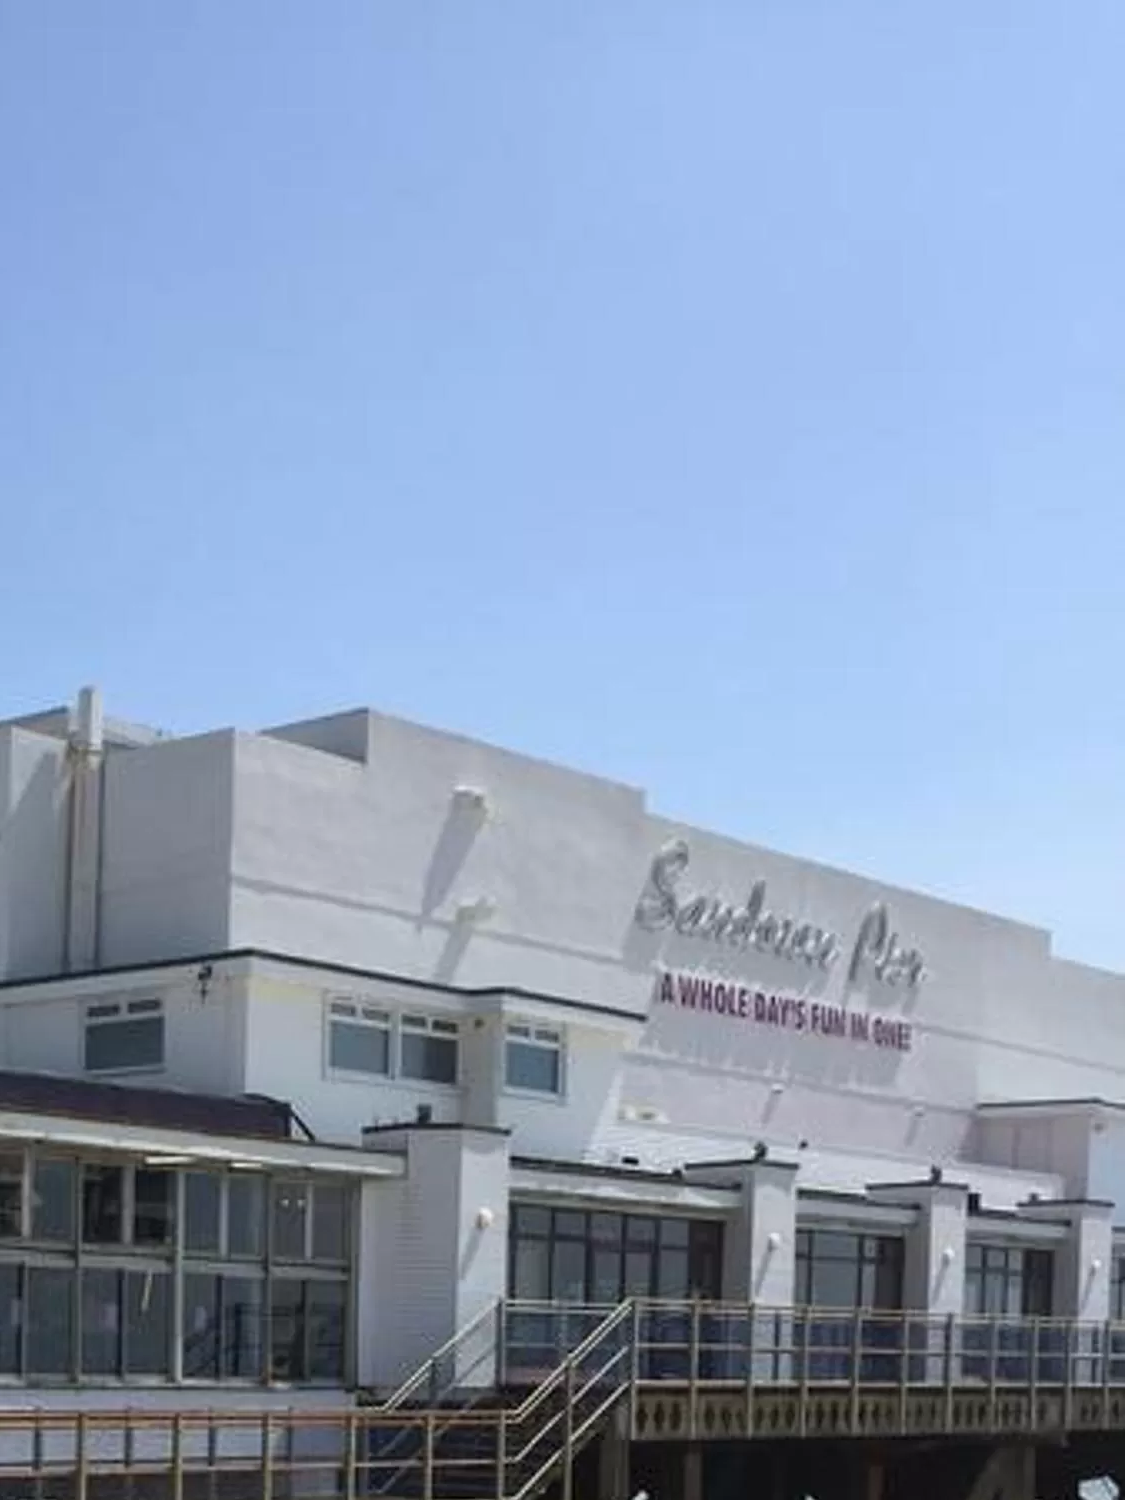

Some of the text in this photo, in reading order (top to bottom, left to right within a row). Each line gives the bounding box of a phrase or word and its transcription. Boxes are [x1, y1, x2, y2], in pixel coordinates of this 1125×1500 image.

[633, 838, 926, 990] Sandown Pier
[661, 971, 673, 1003] A
[677, 975, 748, 1018] WHOLE
[754, 991, 806, 1031] DAY'S
[810, 1003, 847, 1037] FUN
[851, 1012, 870, 1042] IN
